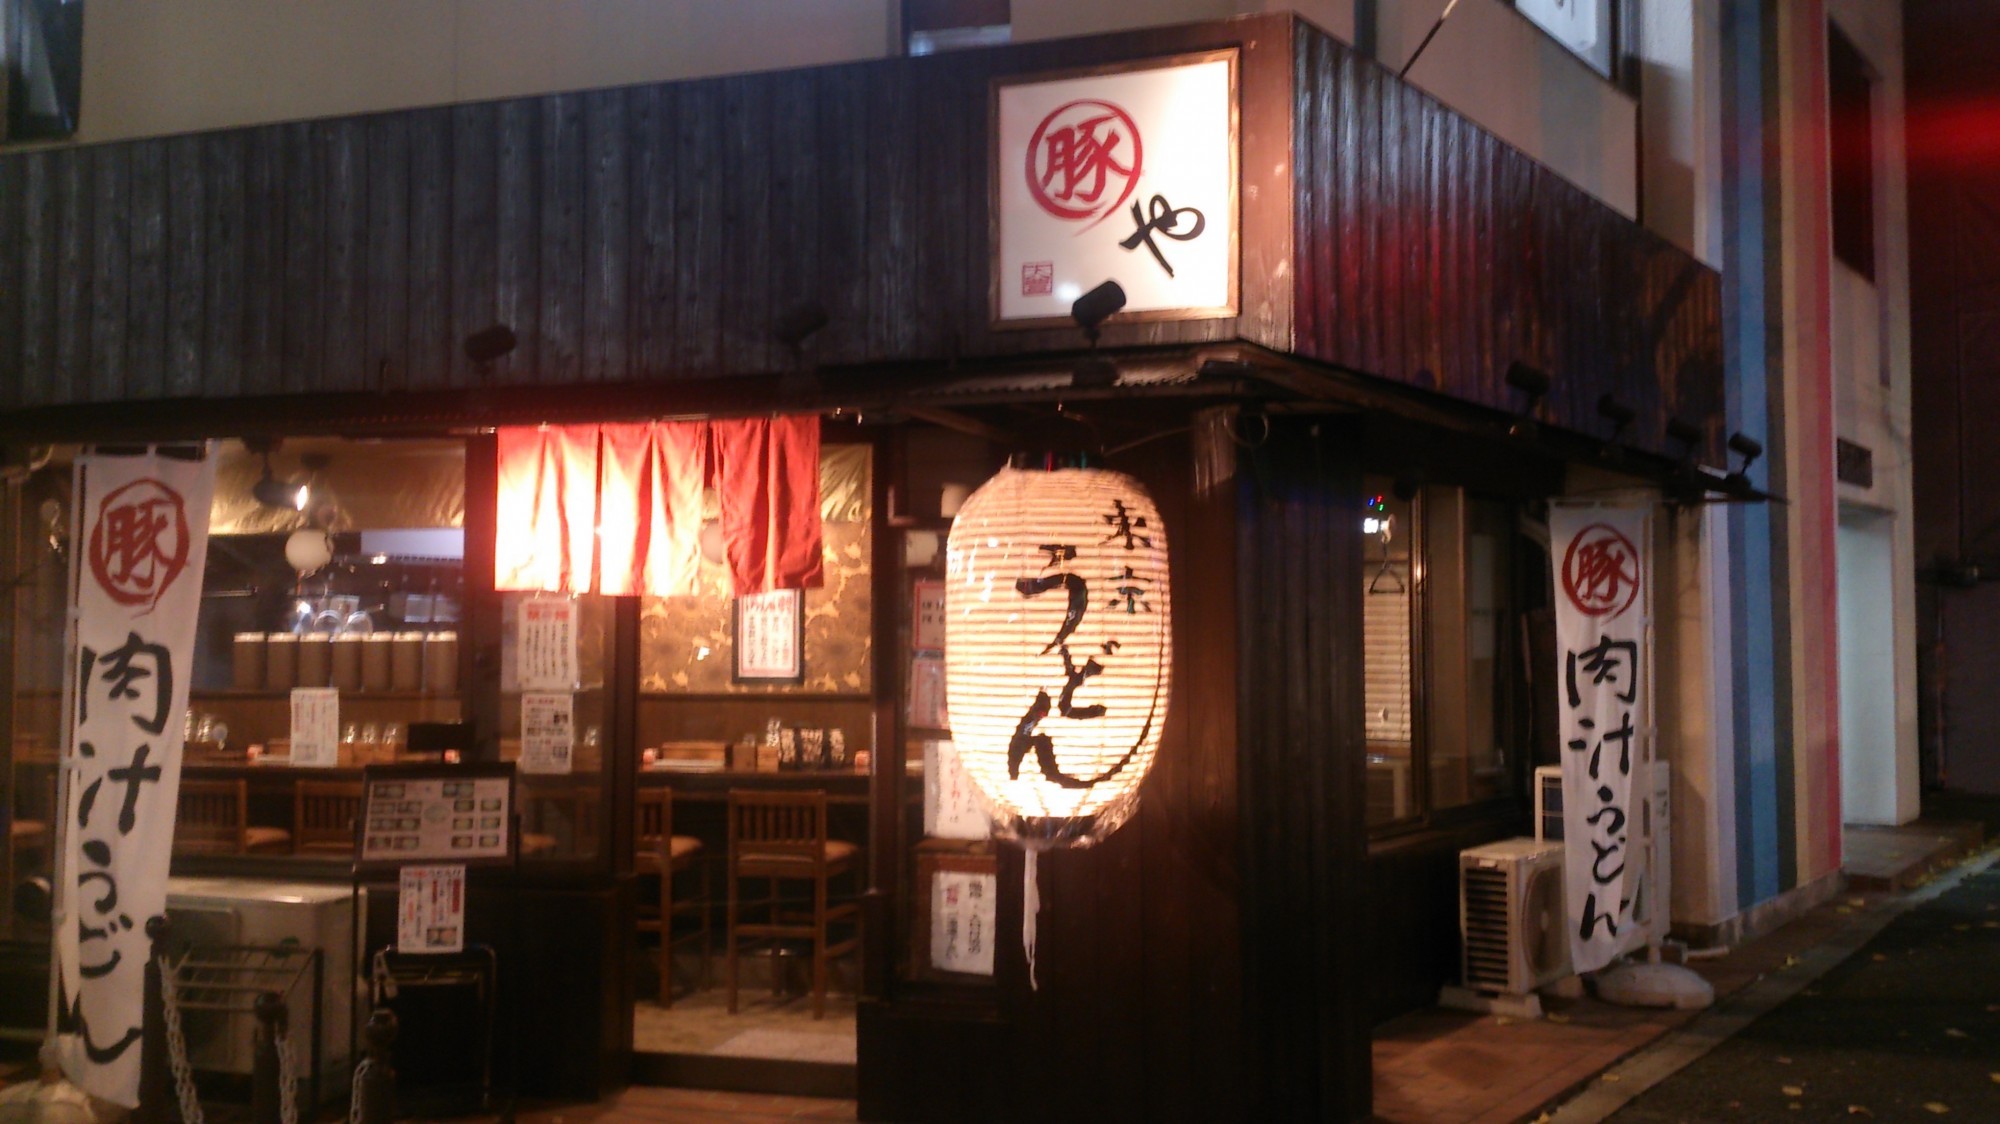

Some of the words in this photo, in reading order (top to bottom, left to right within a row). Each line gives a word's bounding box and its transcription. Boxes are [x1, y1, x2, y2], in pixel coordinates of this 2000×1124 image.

[1041, 112, 1132, 202] 豚
[1118, 195, 1206, 279] や
[104, 502, 172, 588] 豚
[1577, 538, 1635, 601] 豚
[1008, 544, 1162, 789] うどん
[1566, 634, 1638, 942] 肉汁うどん
